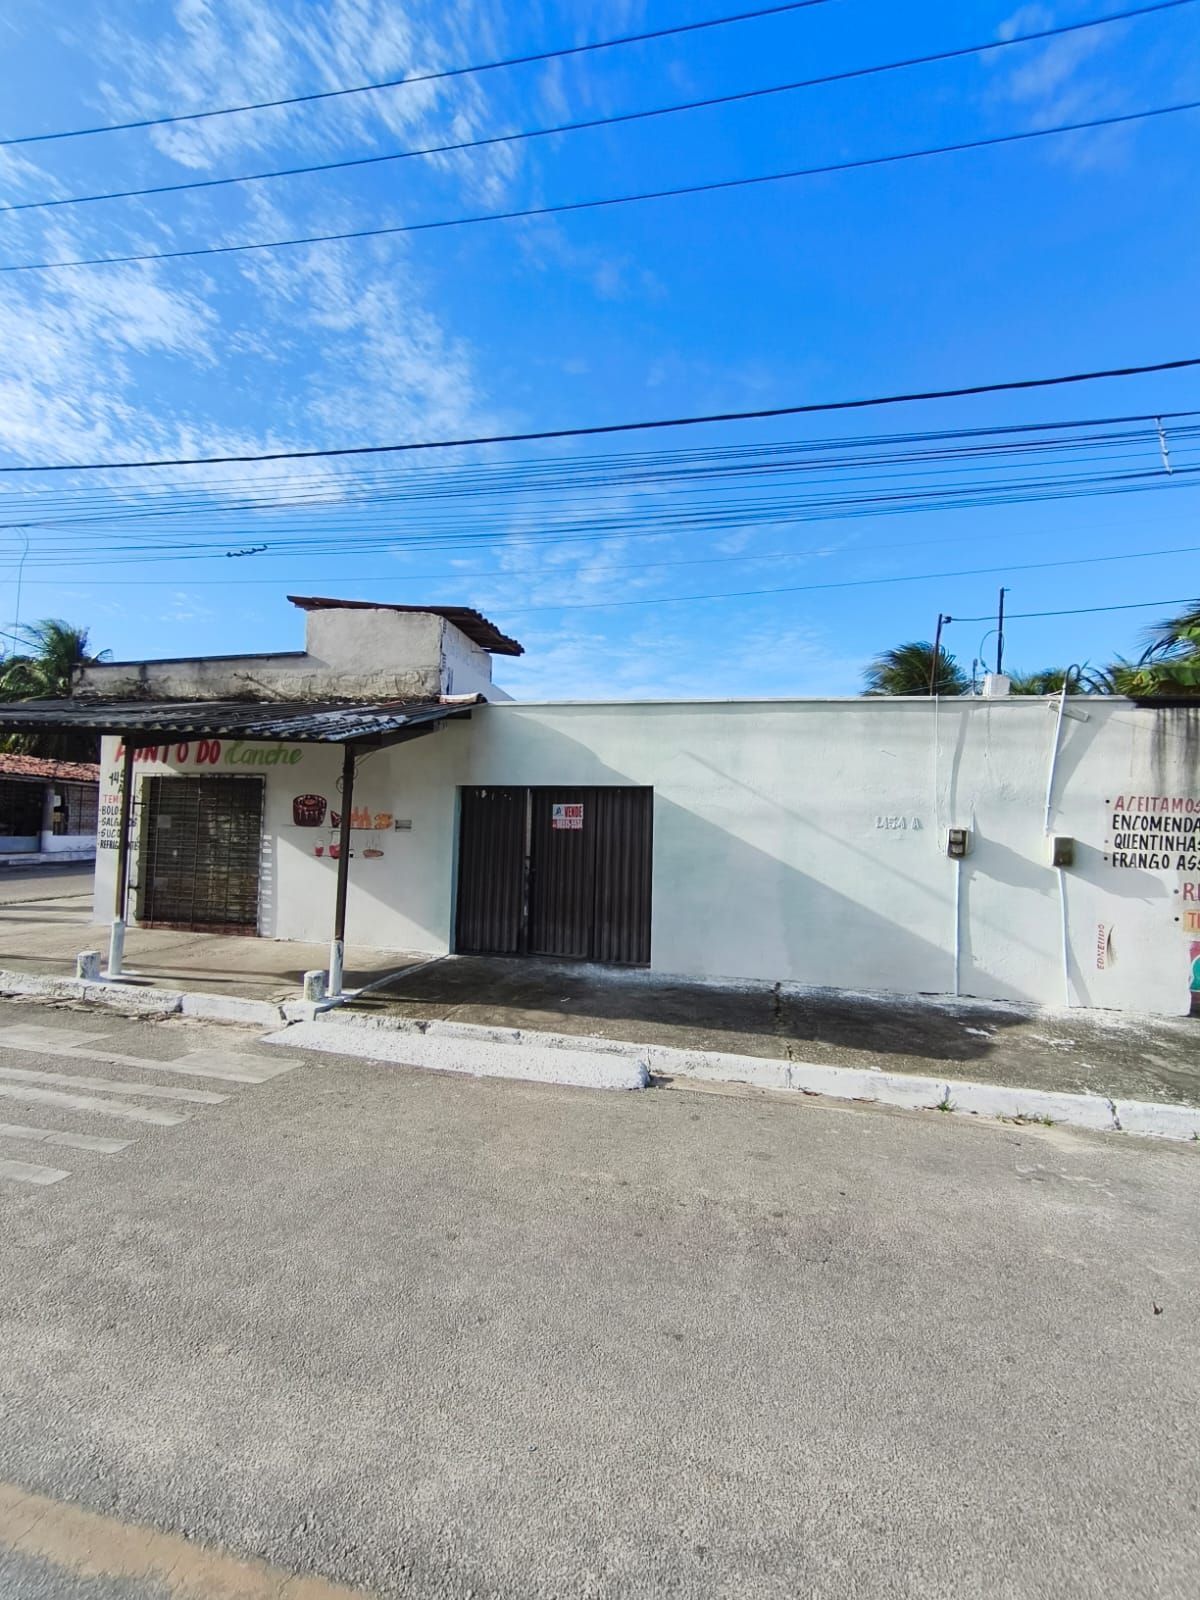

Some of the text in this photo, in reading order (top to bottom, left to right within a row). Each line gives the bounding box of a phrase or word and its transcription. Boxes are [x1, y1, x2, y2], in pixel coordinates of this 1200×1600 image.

[196, 740, 221, 764] DO
[1114, 795, 1200, 814] ACEITAMOS
[100, 828, 121, 838] SUCO
[1112, 852, 1170, 870] FRANGO
